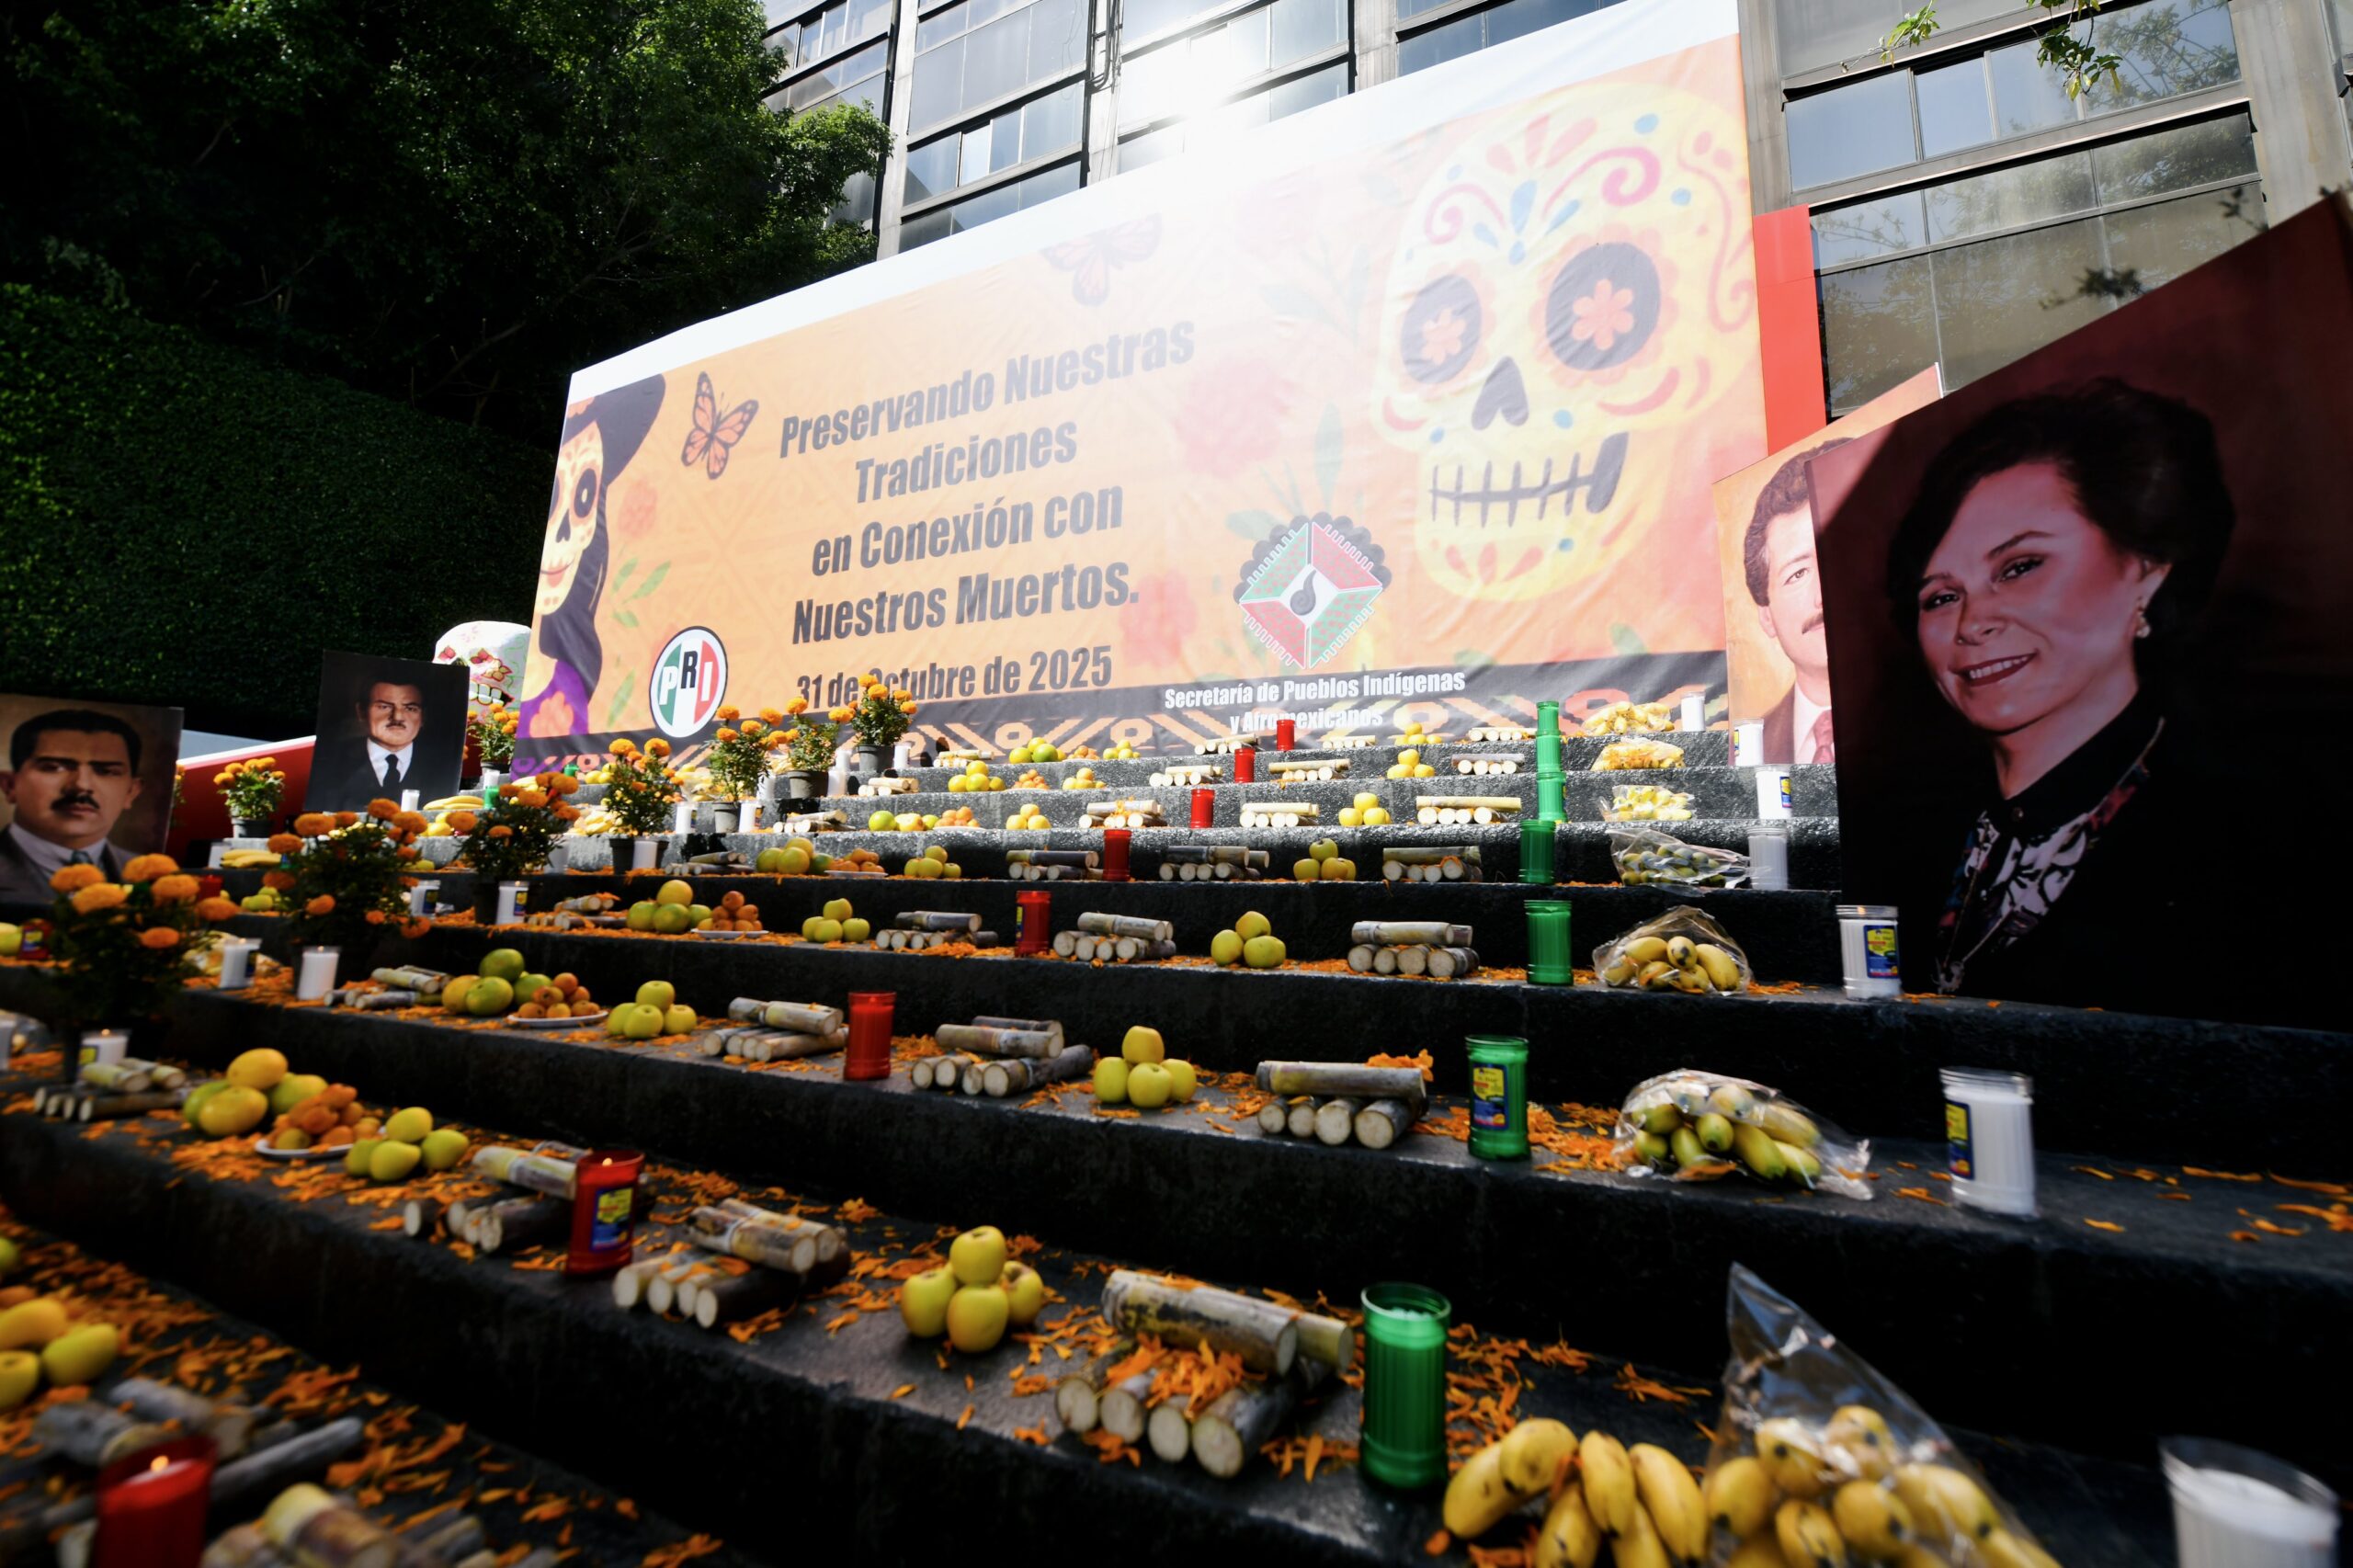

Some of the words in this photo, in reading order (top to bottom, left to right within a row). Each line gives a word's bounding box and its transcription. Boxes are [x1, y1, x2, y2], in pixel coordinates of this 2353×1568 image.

[779, 370, 994, 458] Preservando
[1004, 321, 1196, 404] Nuestras
[856, 421, 1077, 504] Tradiciones
[813, 533, 852, 575] en
[859, 496, 1033, 568] Conexión
[1043, 485, 1123, 539] con
[792, 587, 946, 644] Nuestros
[955, 562, 1139, 625] Muertos.
[659, 650, 713, 705] PRI
[796, 674, 824, 710] 31
[827, 672, 858, 708] de
[983, 655, 1021, 695] de
[1029, 645, 1112, 691] 2025
[1165, 683, 1252, 709] Secretaría
[1256, 682, 1279, 702] de
[1283, 676, 1358, 701] Pueblos
[1363, 671, 1465, 697] Indígenas
[1230, 714, 1241, 735] y
